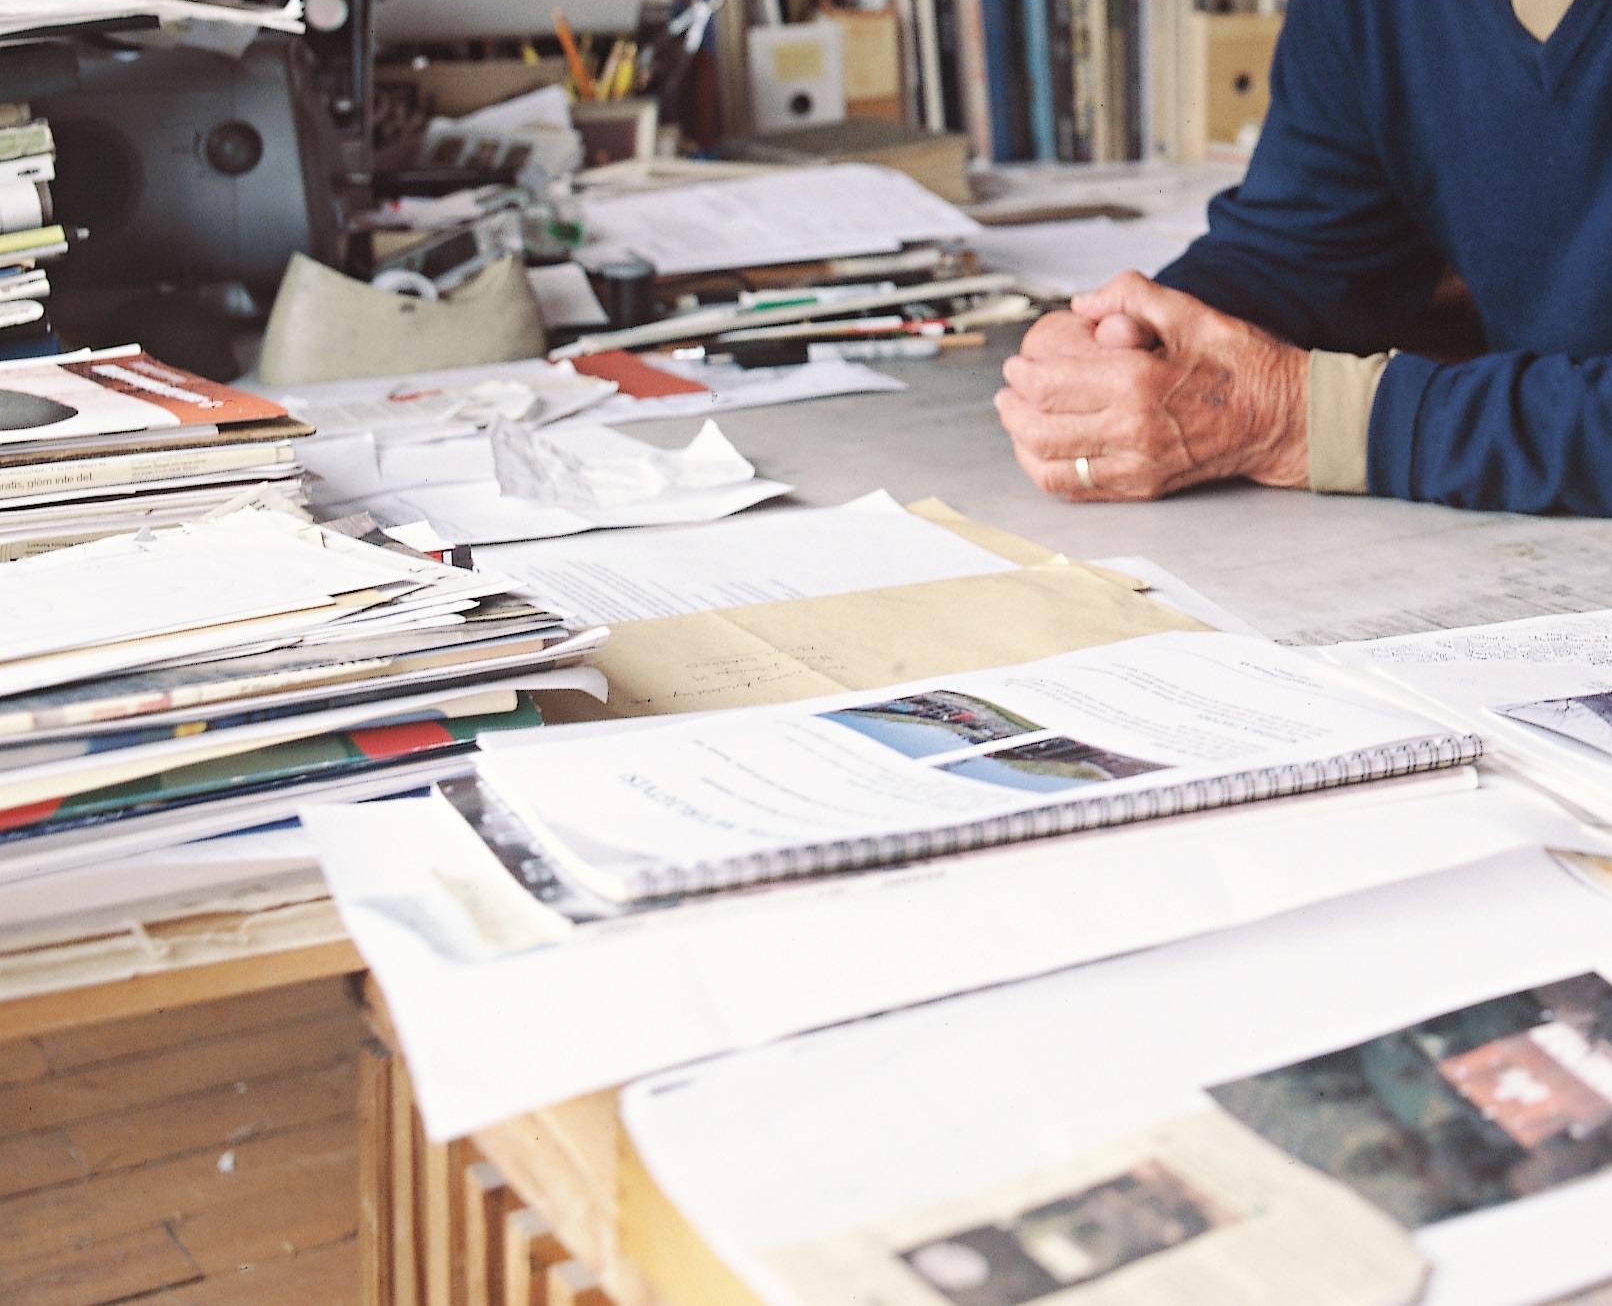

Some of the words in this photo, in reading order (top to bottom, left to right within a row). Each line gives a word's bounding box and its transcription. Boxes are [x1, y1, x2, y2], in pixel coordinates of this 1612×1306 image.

[0, 479, 25, 491] ratis,
[27, 477, 52, 491] glöm
[55, 474, 74, 485] inte
